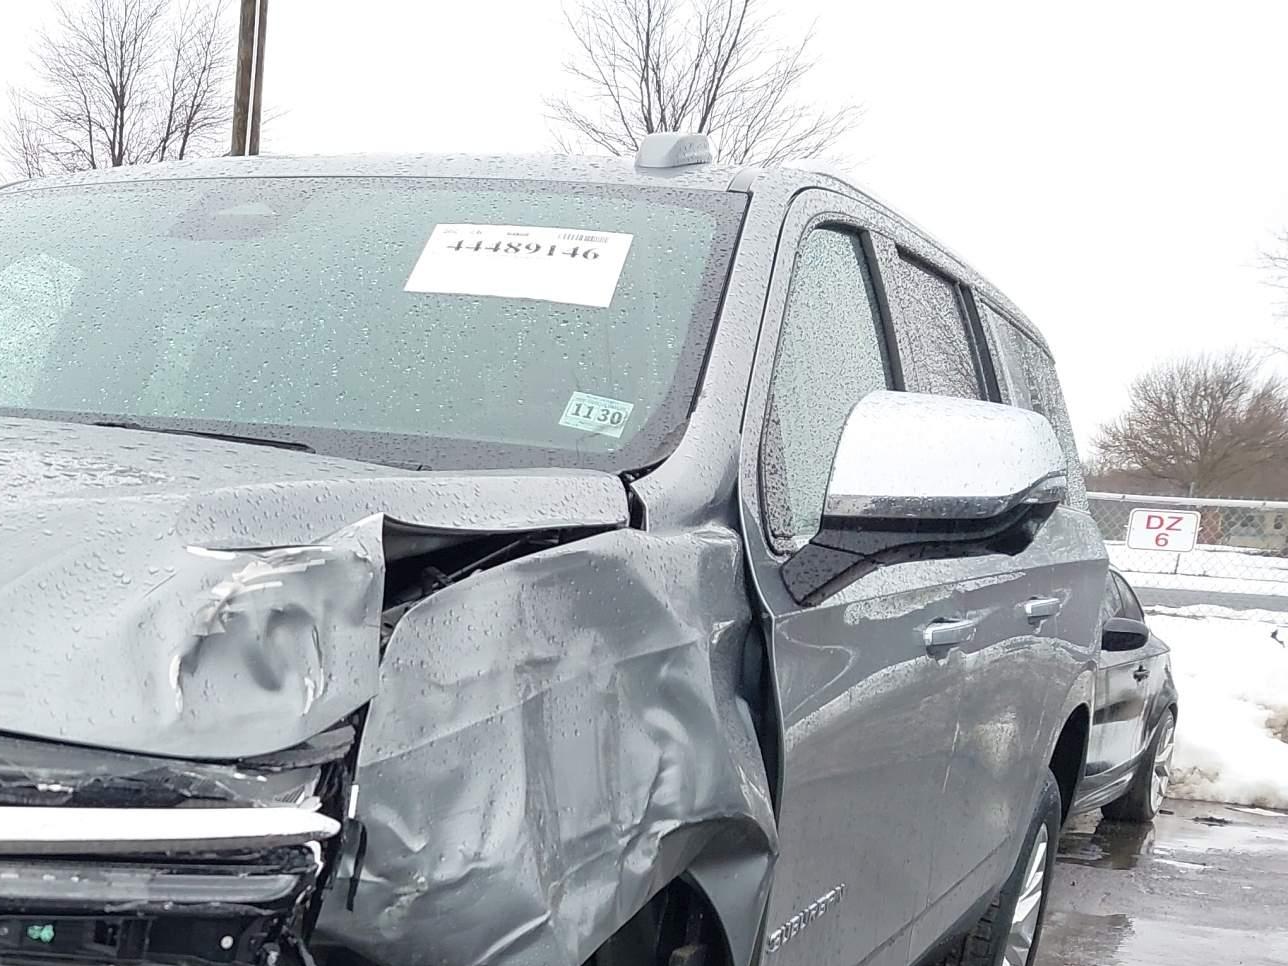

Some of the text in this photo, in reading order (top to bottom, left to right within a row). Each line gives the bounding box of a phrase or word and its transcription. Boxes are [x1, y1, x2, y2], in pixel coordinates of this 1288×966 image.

[446, 239, 601, 261] 44489146
[571, 403, 623, 425] 11 30
[1145, 514, 1184, 531] DZ
[1154, 532, 1169, 547] 6
[766, 883, 846, 953] SUBURBAN
